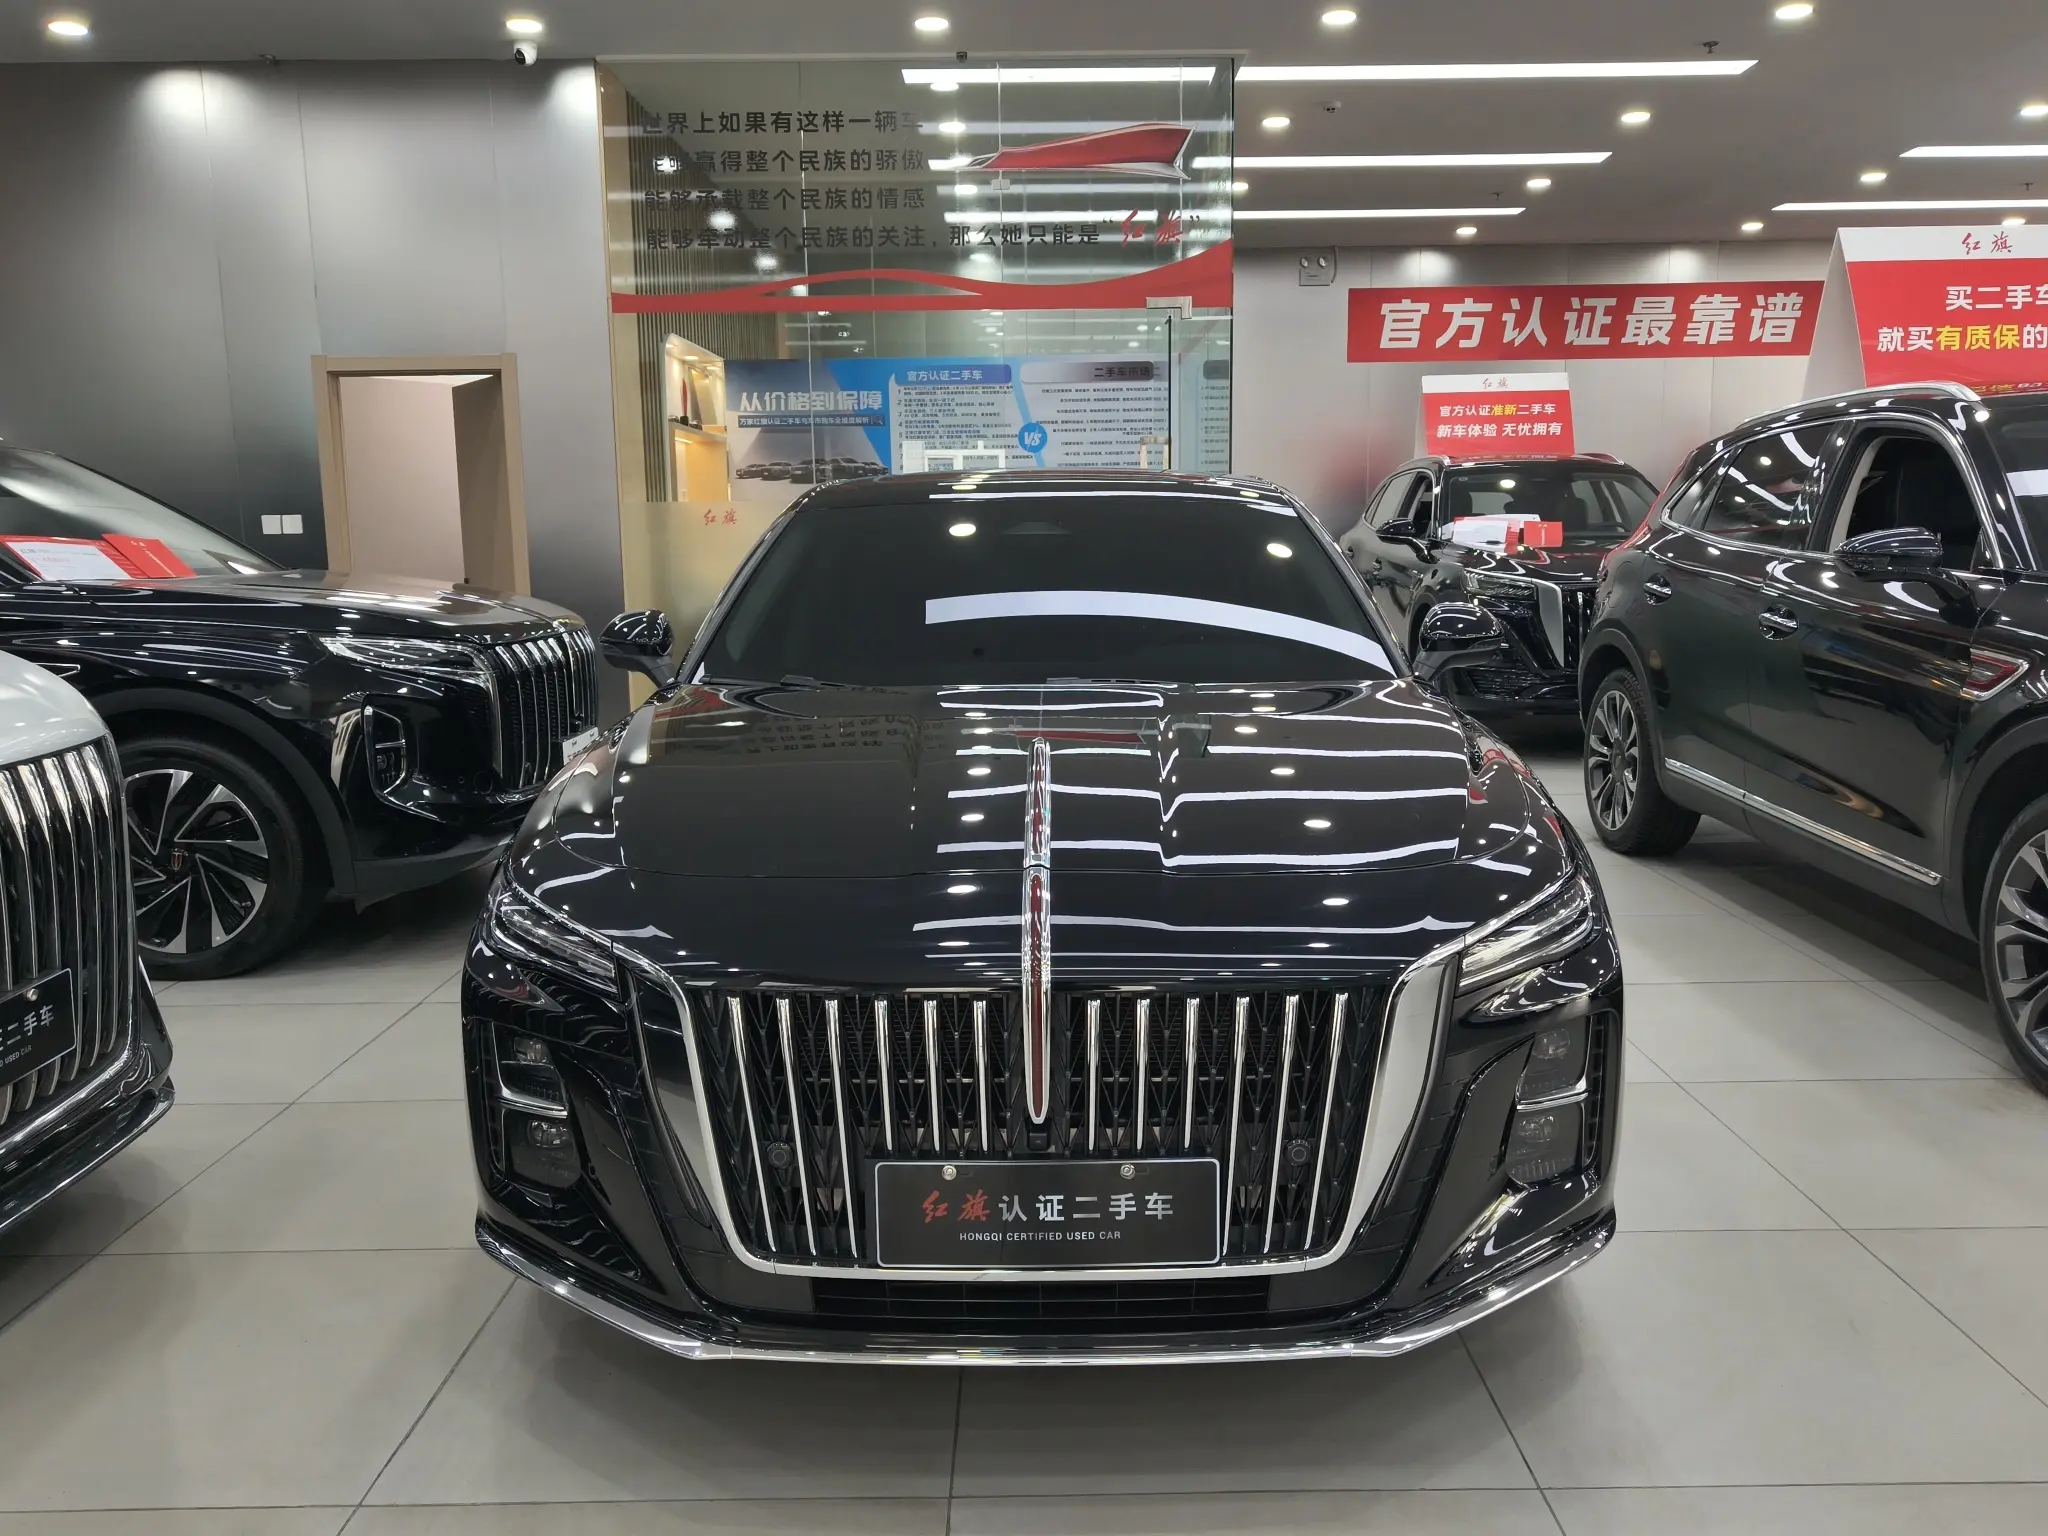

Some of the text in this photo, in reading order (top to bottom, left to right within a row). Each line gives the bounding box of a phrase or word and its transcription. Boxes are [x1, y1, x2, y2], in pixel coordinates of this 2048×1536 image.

[1962, 231, 2013, 255] 红旗
[1379, 293, 1804, 349] 官方认证最靠谱
[1877, 324, 2048, 352] 就买有质保的
[906, 370, 983, 381] 官方认证二手车
[1482, 376, 1509, 390] 红旗
[739, 390, 883, 412] 从价格到保障
[1439, 403, 1556, 417] 官方认证准新二手车
[1437, 422, 1563, 438] 新车体验 无忧拥有
[703, 509, 738, 526] 红旗
[959, 1230, 1121, 1242] HONGQI CERTIFIED USED CAR
